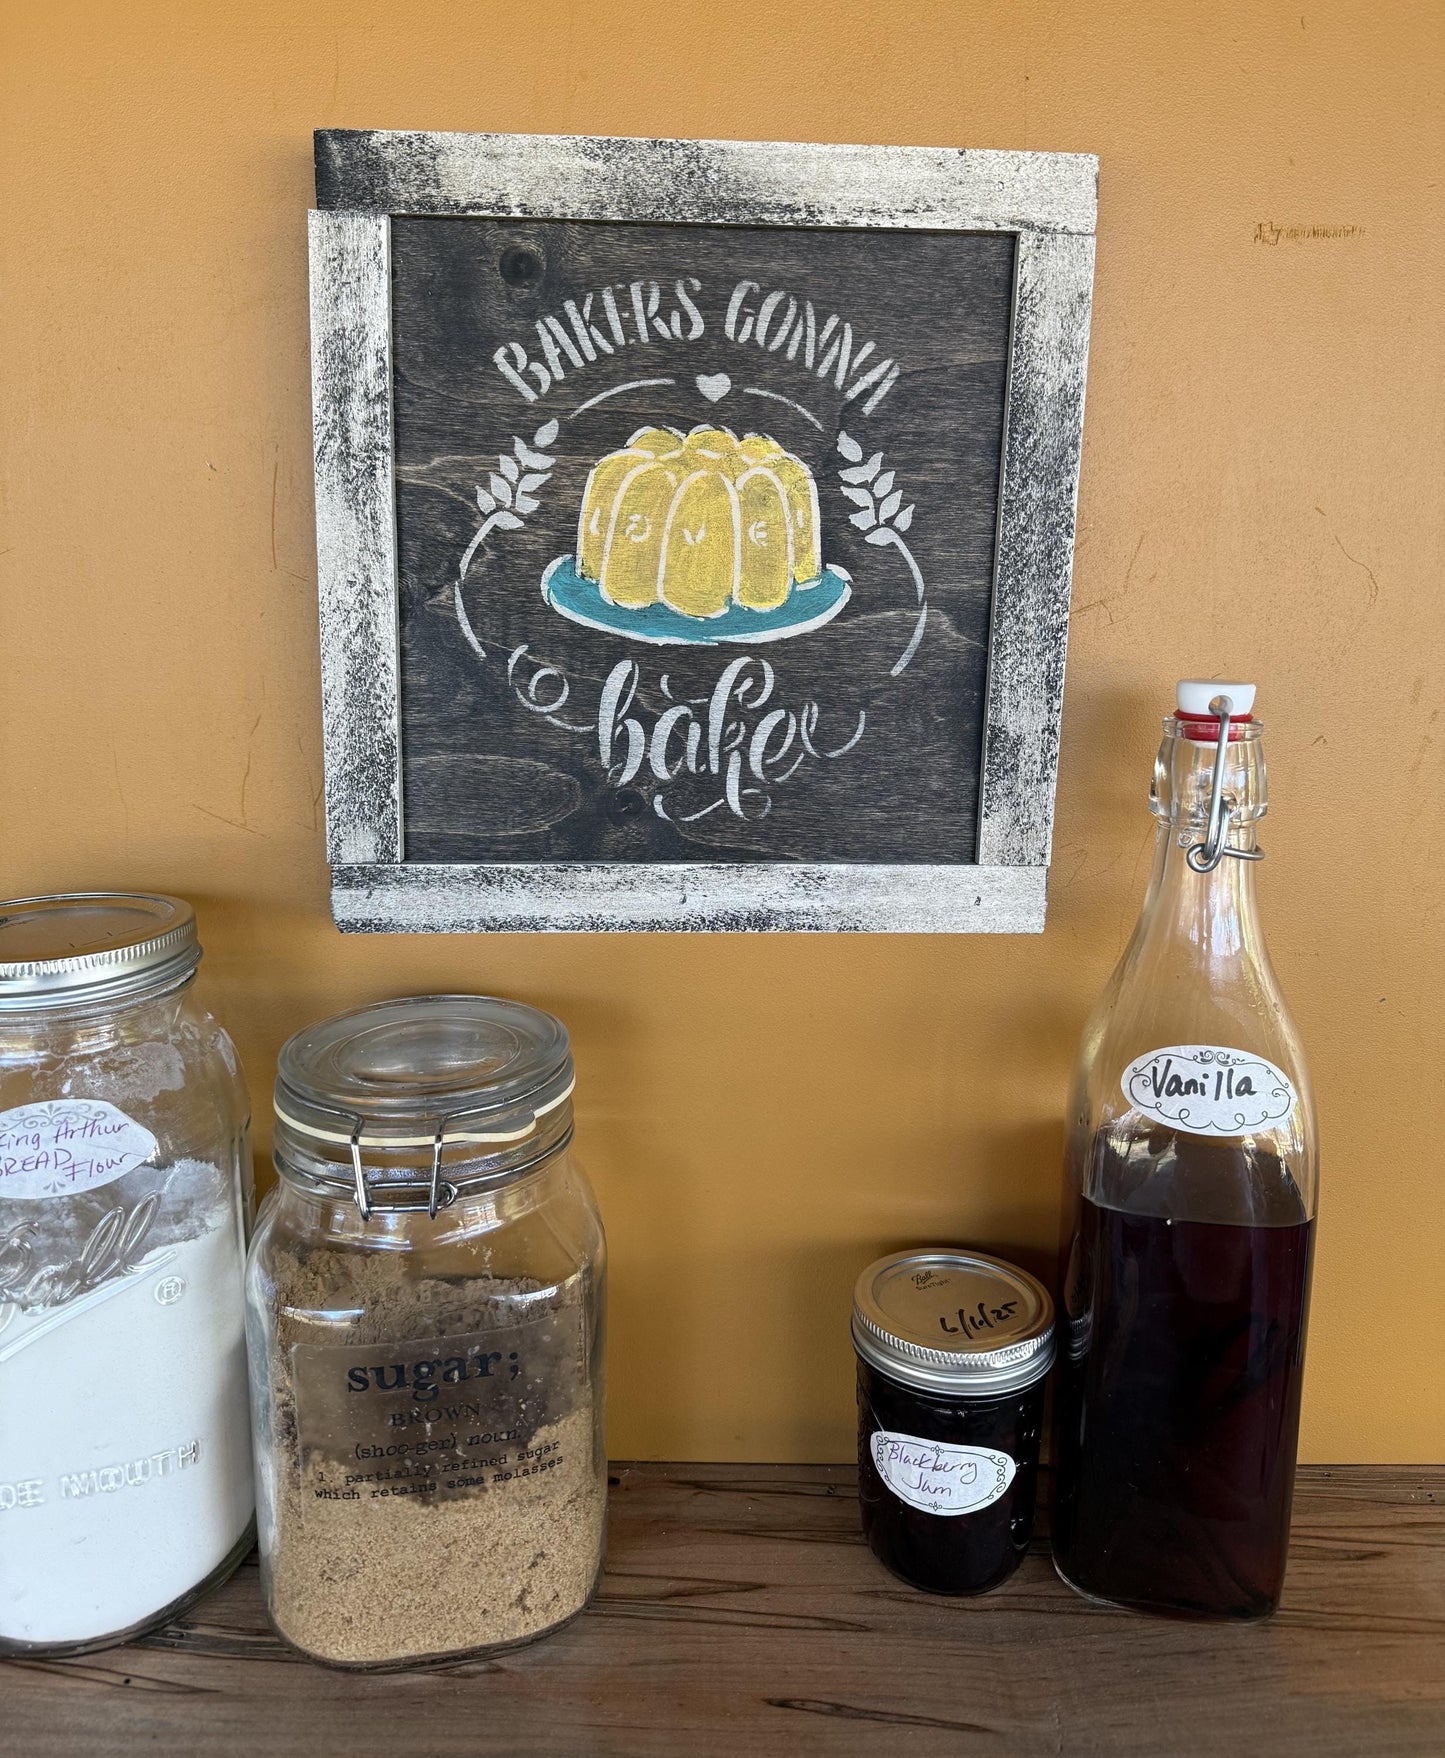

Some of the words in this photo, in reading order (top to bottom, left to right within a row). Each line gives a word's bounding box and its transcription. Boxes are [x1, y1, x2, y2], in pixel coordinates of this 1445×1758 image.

[491, 277, 704, 403] BAKERS
[724, 280, 901, 415] GONNA
[597, 655, 867, 822] bake
[1152, 1058, 1258, 1101] Vanilla
[53, 1118, 130, 1144] Arthur
[0, 1147, 72, 1177] READ
[62, 1151, 132, 1181] Flour
[347, 1351, 520, 1402] sugar;
[390, 1402, 481, 1428] BROWN
[60, 1438, 203, 1498] MOUTH
[314, 1487, 361, 1501] which
[370, 1481, 437, 1498] retains
[447, 1474, 485, 1489] some
[493, 1455, 564, 1483] molasses
[345, 1464, 433, 1486] partially
[442, 1454, 508, 1473] refined
[516, 1439, 560, 1463] sugar
[901, 1472, 952, 1498] Jam
